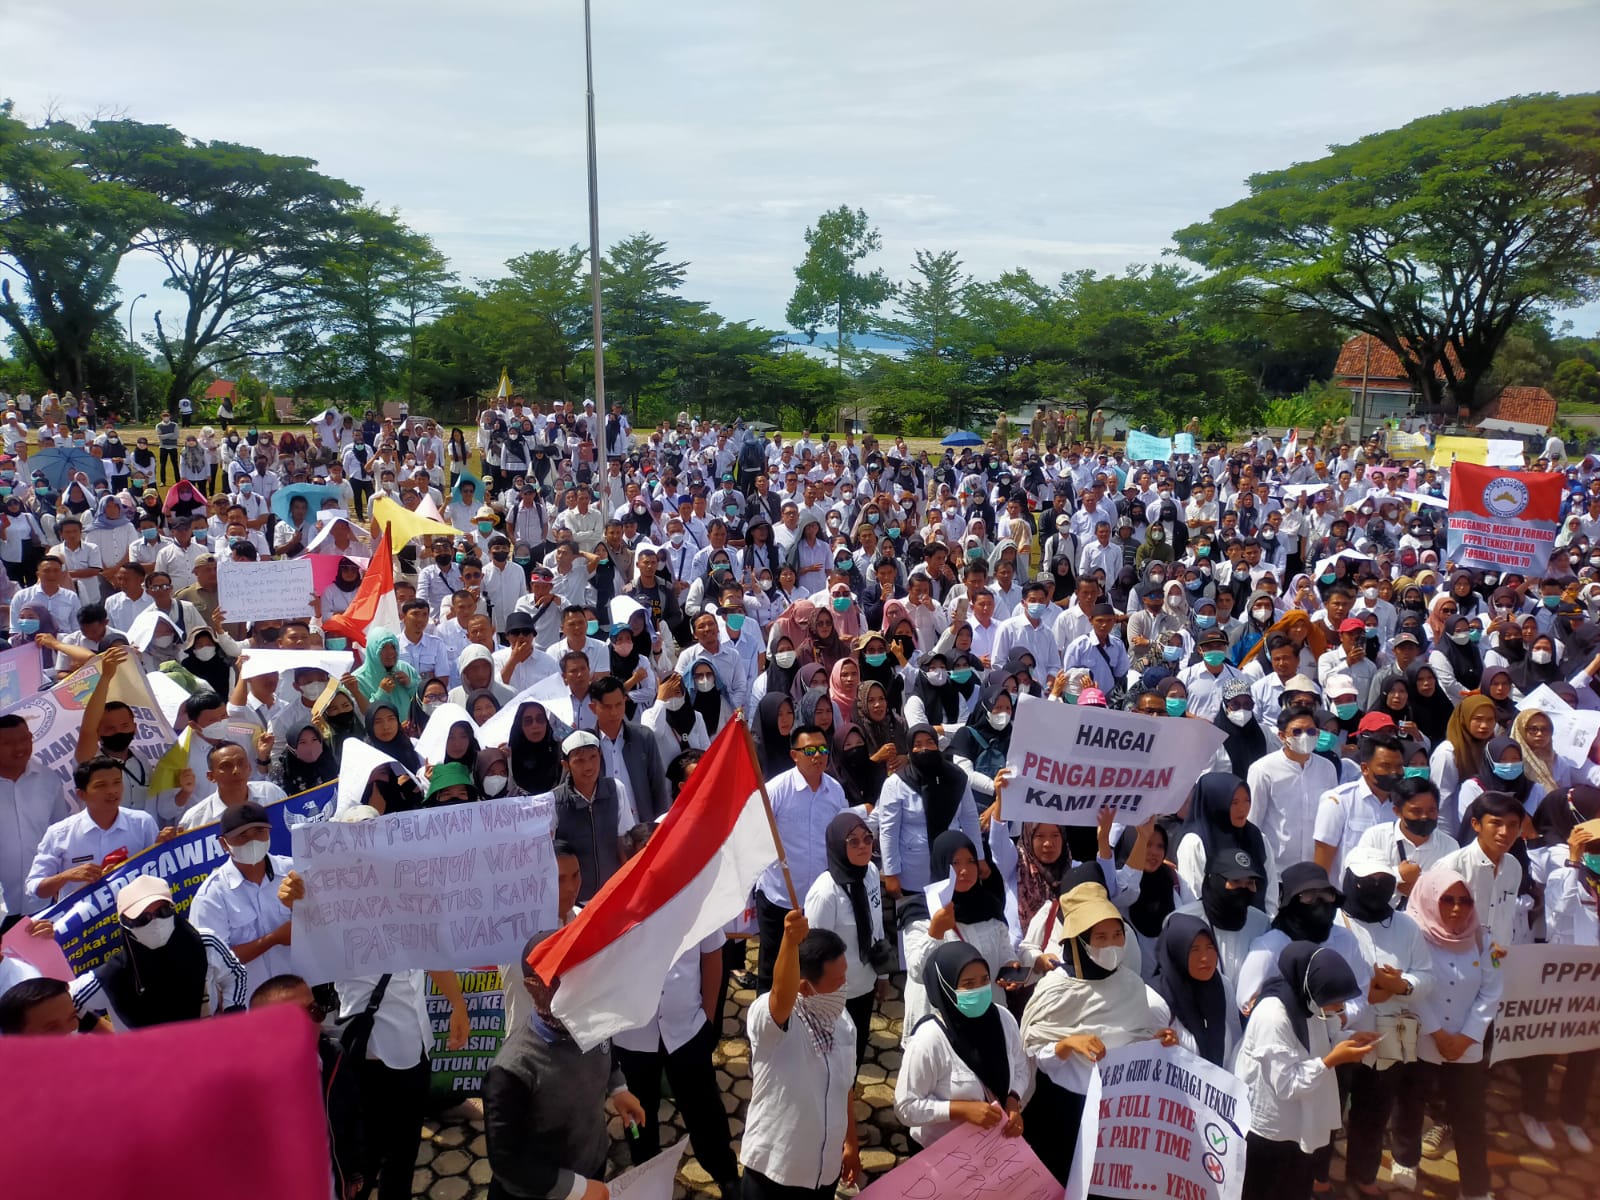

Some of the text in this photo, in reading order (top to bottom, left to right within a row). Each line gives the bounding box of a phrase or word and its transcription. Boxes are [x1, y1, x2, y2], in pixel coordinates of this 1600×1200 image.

[1449, 518, 1554, 542] TANGGAMUS MISKIN FORMASI
[1513, 540, 1535, 553] BUKA
[1464, 549, 1496, 562] FORMASI
[1497, 553, 1519, 566] HANYA
[1075, 724, 1155, 753] HARGAI
[1021, 751, 1175, 789] PENGABDIAN
[1024, 787, 1097, 812] KAMI
[385, 808, 473, 846] PELAYAN
[301, 858, 378, 898] KERJA
[393, 847, 477, 889] PENUH
[396, 887, 483, 915] STATUS
[342, 909, 542, 969] PARUH WAKTU
[1110, 1063, 1124, 1086] R3
[1126, 1059, 1152, 1082] GURU
[1152, 1058, 1162, 1081] &
[1165, 1062, 1202, 1101] TENAGA
[1204, 1082, 1238, 1121] TEKNIS
[1116, 1094, 1152, 1118] FULL
[1157, 1097, 1197, 1133] TIME
[1110, 1125, 1152, 1151] PART
[1155, 1129, 1192, 1162] TIME
